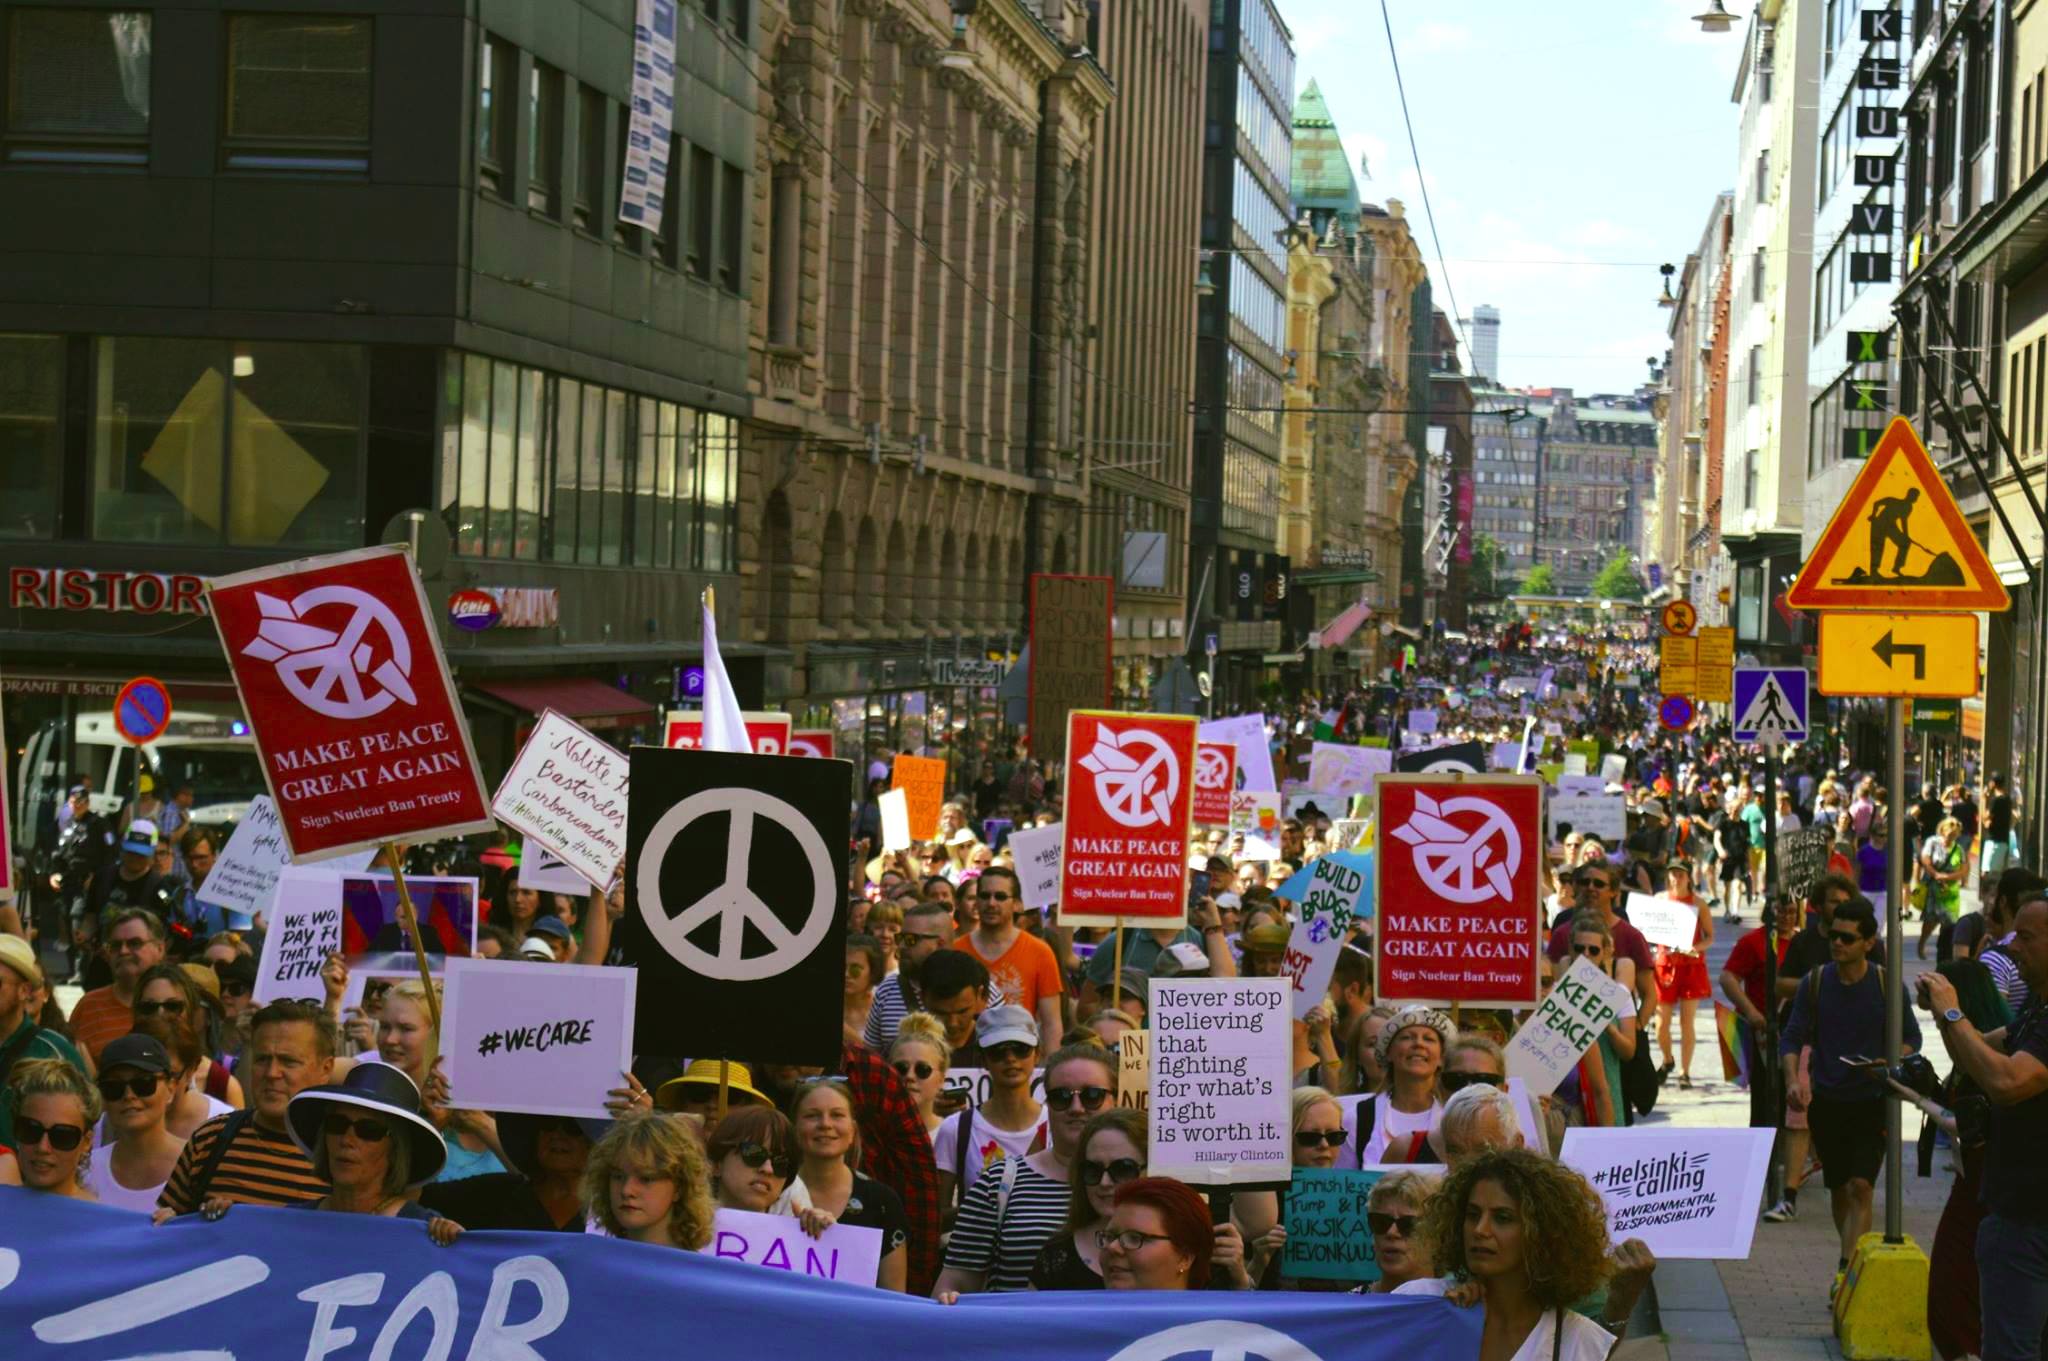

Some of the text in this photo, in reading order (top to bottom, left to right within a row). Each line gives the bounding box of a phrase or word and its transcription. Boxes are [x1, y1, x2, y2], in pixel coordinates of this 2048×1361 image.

[1864, 13, 1891, 279] KLUUVI
[9, 567, 206, 616] RISTOR
[274, 722, 449, 772] MAKE PEACE
[281, 750, 461, 801] GREAT AGAIN
[301, 790, 461, 829] Sign Nuclear Ban Treaty
[1072, 838, 1181, 856] MAKE PEACE
[1069, 861, 1181, 877] GREAT AGAIN
[1315, 858, 1361, 893] BUILD
[1073, 888, 1175, 902] Sign Nuclear Ban Treaty
[284, 914, 305, 928] WE
[1301, 889, 1352, 939] BRIDGES
[1388, 915, 1528, 935] MAKE PEACE
[280, 927, 315, 948] PAY
[279, 946, 310, 963] THAT
[1284, 947, 1312, 973] NOT
[1384, 940, 1530, 959] GREAT AGAIN
[1392, 969, 1522, 985] Sign Nuclear Ban Treaty
[1158, 988, 1282, 1010] Never stop
[1556, 975, 1614, 1025] KEEP
[1157, 1012, 1263, 1033] believing
[1536, 998, 1595, 1052] PEACE
[478, 1019, 595, 1058] #WECARE
[1123, 1035, 1144, 1057] IN
[1158, 1035, 1207, 1053] that
[1158, 1056, 1247, 1079] fighting
[1157, 1077, 1272, 1098] for what's
[1157, 1102, 1216, 1124] right
[1157, 1122, 1281, 1142] is worth it.
[1195, 1150, 1285, 1163] Hillary Clinton
[1592, 1151, 1687, 1187] #Helsinki
[1290, 1170, 1342, 1193] Finnish
[1636, 1168, 1705, 1198] calling
[1286, 1193, 1326, 1213] Trump
[1614, 1192, 1717, 1219] ENVIRONMENTAL
[1614, 1206, 1715, 1232] RESPONSIBILITY
[297, 1254, 569, 1361] FOR
